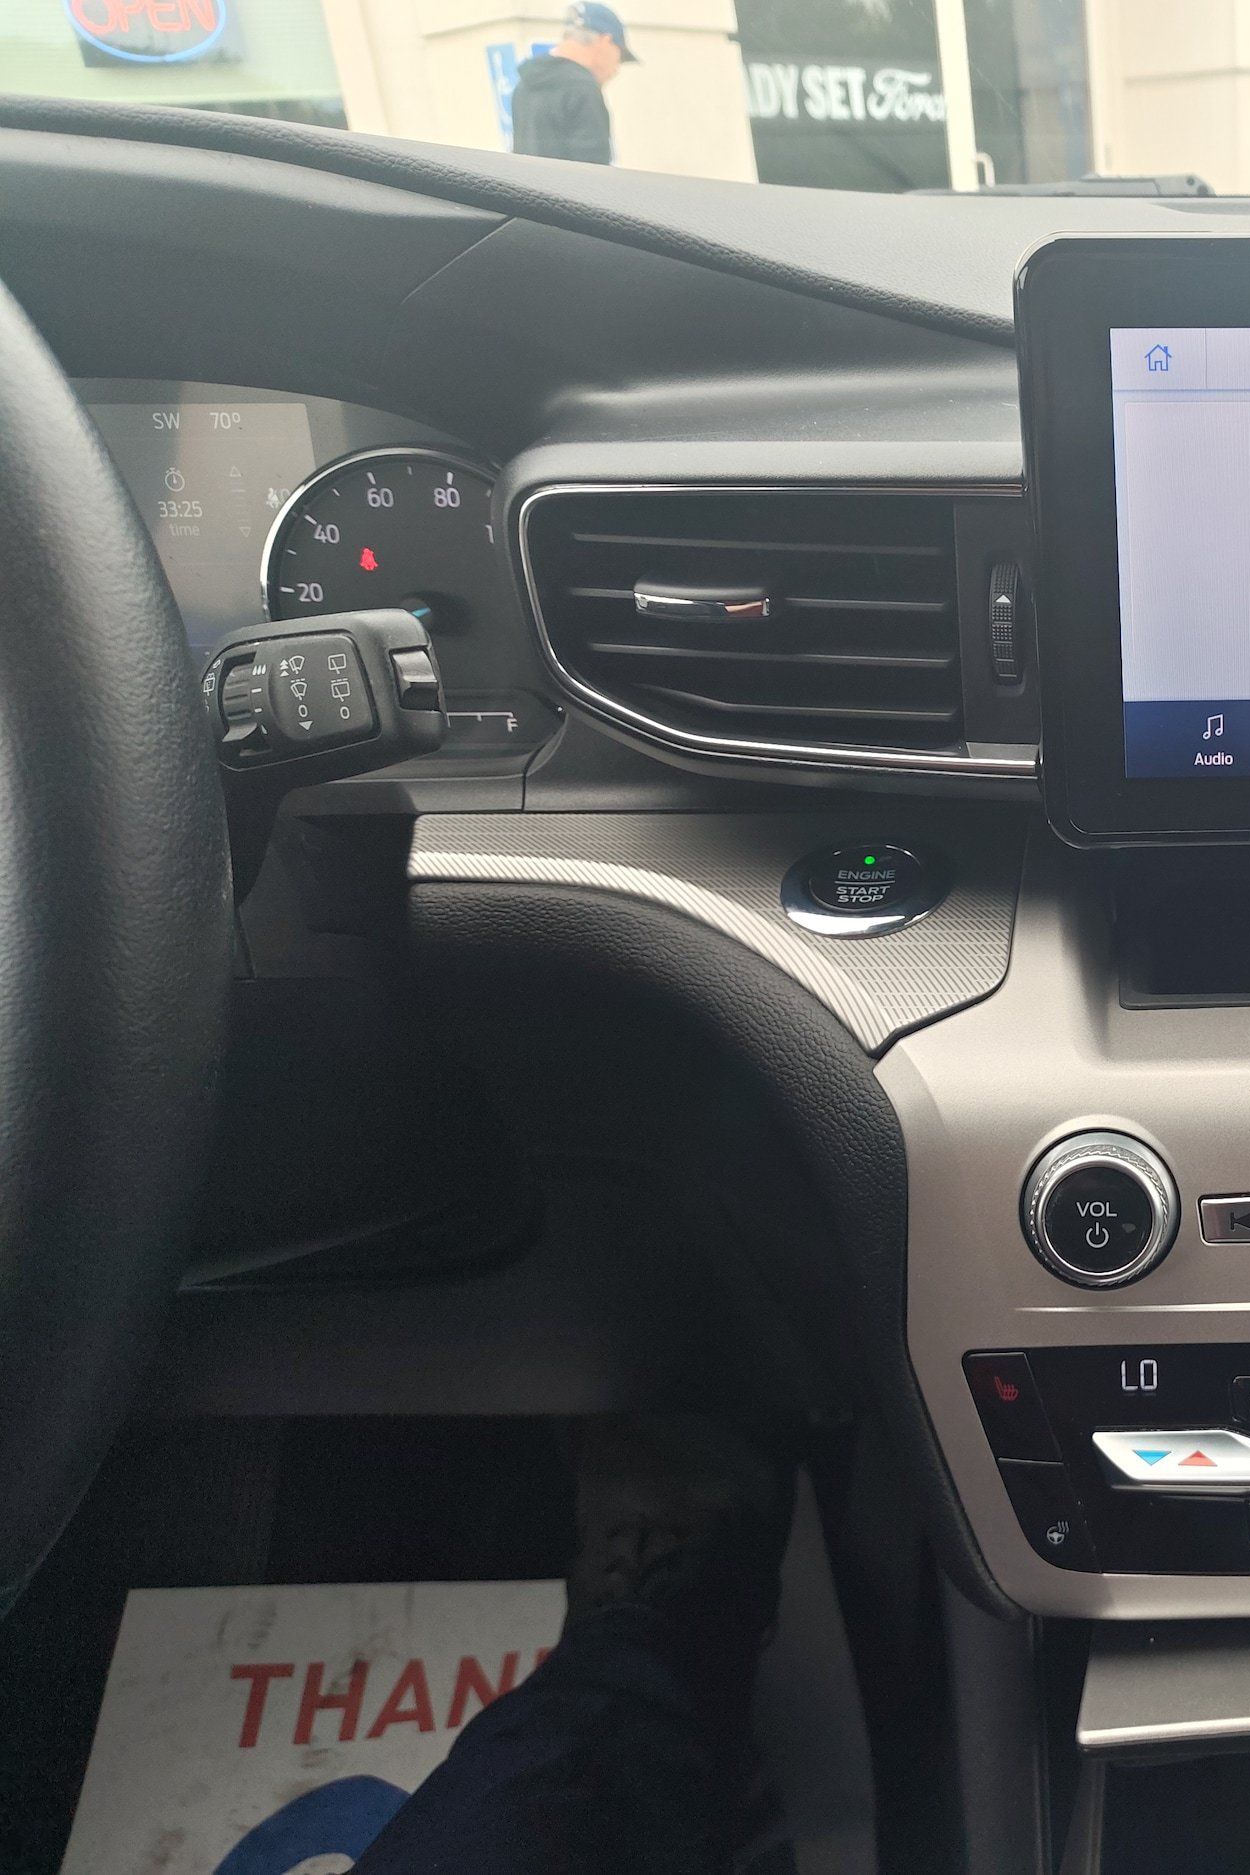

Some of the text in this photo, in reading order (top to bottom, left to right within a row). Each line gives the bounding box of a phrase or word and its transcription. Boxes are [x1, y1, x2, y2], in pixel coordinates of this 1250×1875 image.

[70, 0, 218, 34] OPEN
[802, 64, 866, 120] SET
[152, 412, 180, 430] SW
[367, 488, 394, 508] 60
[434, 488, 461, 507] 80
[158, 501, 203, 518] 33:25
[169, 523, 200, 537] time
[314, 524, 340, 545] 40
[297, 583, 323, 602] 20
[507, 718, 518, 732] F
[1194, 752, 1234, 766] Audio
[837, 869, 896, 880] ENGINE
[836, 885, 891, 895] START
[837, 895, 884, 903] STOP
[1077, 1201, 1118, 1217] VOL
[1121, 1359, 1158, 1391] LO
[229, 1646, 559, 1748] THAN
